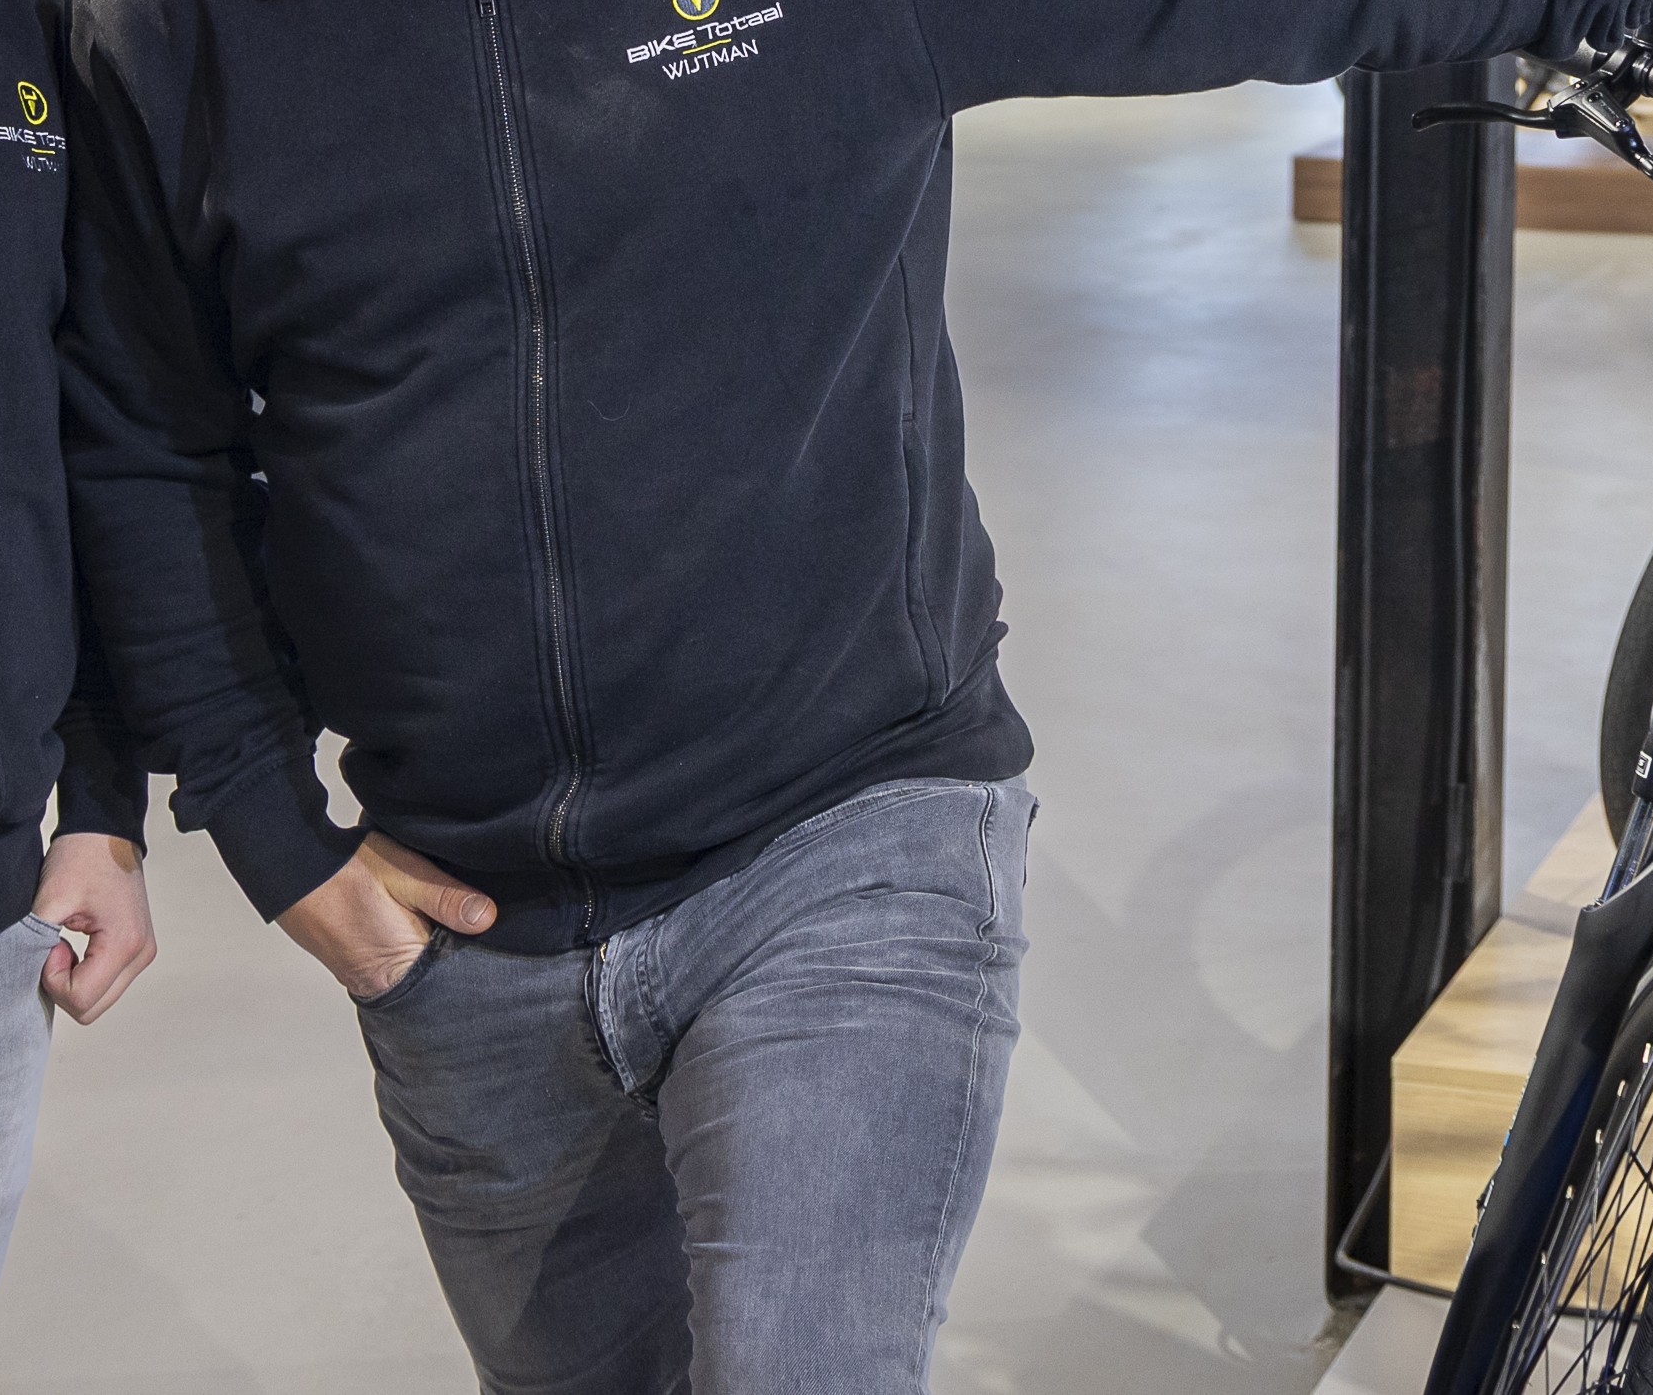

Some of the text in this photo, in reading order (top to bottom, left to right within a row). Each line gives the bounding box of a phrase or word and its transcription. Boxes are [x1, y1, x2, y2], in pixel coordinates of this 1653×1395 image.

[626, 2, 784, 64] BIKE Totaal
[662, 38, 759, 81] WIJTMAN
